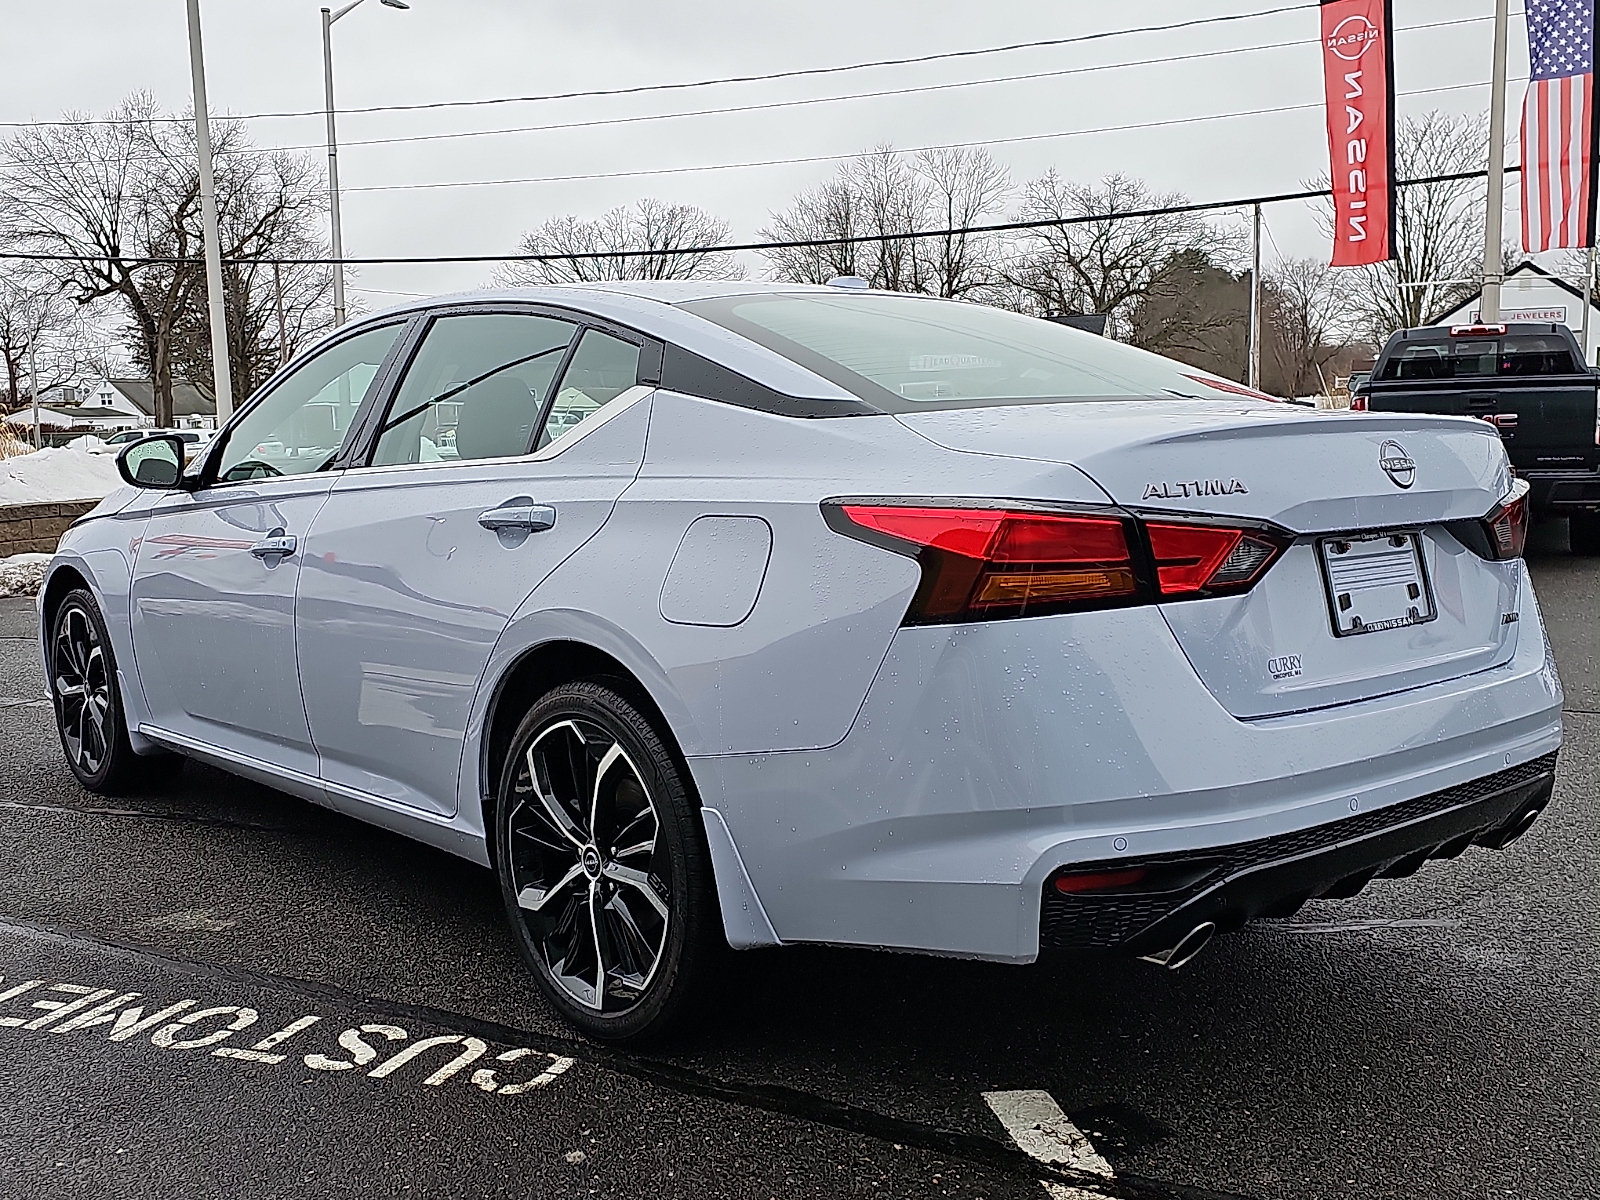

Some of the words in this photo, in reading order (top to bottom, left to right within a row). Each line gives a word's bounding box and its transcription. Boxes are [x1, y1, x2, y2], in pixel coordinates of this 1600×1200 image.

[1510, 311, 1562, 320] JEWELERS
[1142, 479, 1249, 501] ALTIMA
[1267, 654, 1302, 674] CURRY
